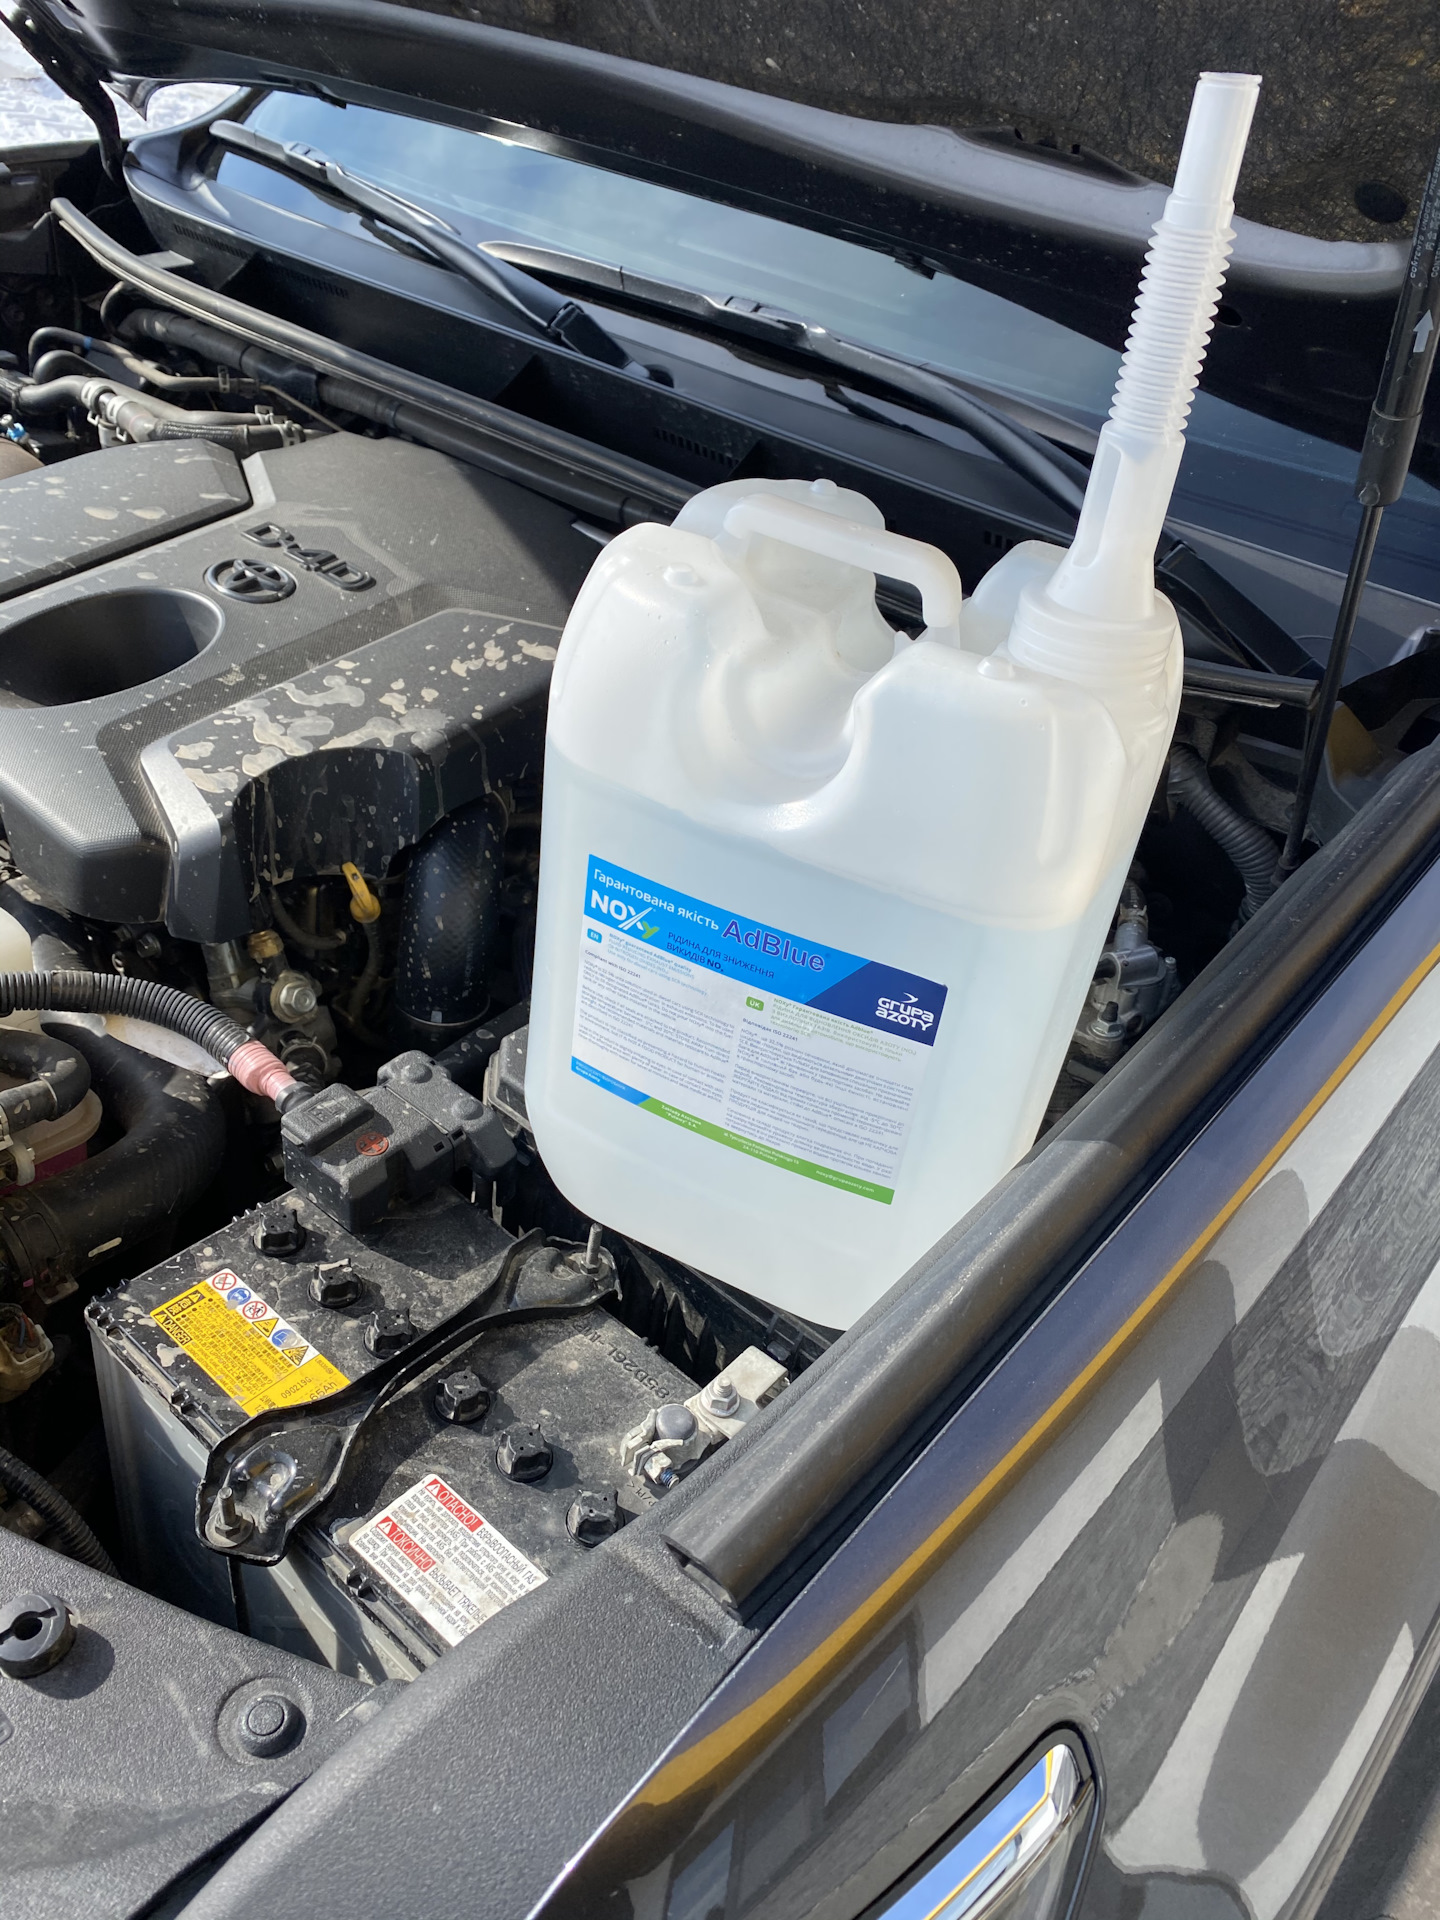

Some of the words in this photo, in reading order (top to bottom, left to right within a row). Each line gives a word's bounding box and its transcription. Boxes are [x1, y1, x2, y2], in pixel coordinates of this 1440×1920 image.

[594, 868, 675, 913] Гарантована
[677, 905, 719, 930] якість
[666, 942, 705, 964] ВИКИДІВ
[668, 931, 700, 951] РІДИНА
[701, 945, 721, 960] ДЛЯ
[722, 953, 774, 979] ЗНИЖЕННЯ
[721, 919, 825, 972] AdBlue
[161, 1318, 192, 1345] DANGER
[279, 1375, 312, 1399] 090219G
[307, 1380, 338, 1402] 65Ah
[436, 1489, 478, 1528] ОПАСНО!
[475, 1527, 528, 1574] ВЗРЫВООПАСНЫЙ
[521, 1570, 538, 1584] ГАЗ
[387, 1527, 435, 1571] ТОКСИЧНО
[428, 1567, 461, 1598] ВЫЗЫВАЕТ
[455, 1594, 488, 1624] ТЯЖЕЛЫЕ
